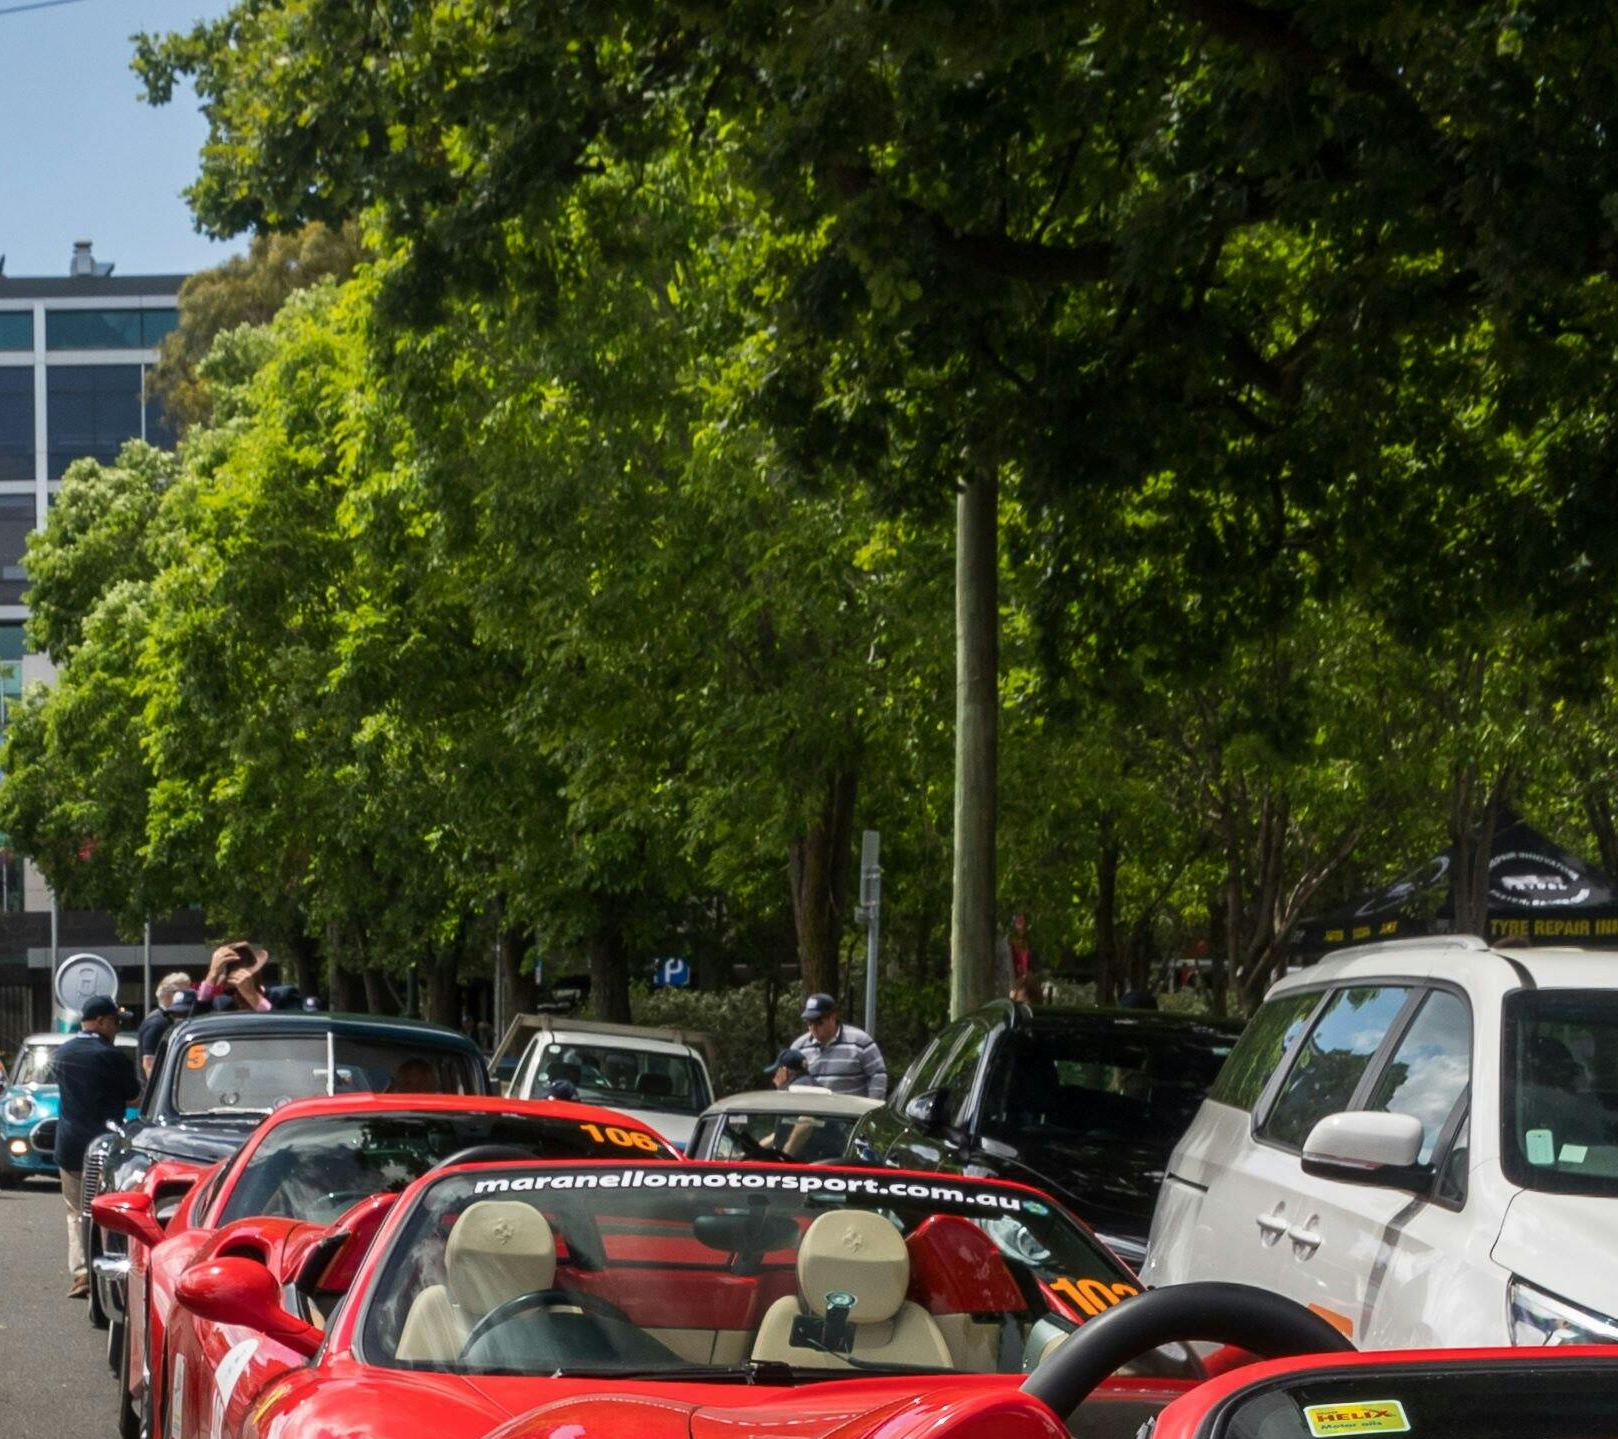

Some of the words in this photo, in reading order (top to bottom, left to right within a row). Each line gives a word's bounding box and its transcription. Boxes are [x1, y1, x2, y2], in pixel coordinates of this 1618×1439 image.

[1490, 919, 1529, 937] TYRE
[1534, 917, 1590, 937] REPAIR
[186, 1044, 208, 1070] 5
[579, 1123, 659, 1152] 106
[474, 1170, 1022, 1212] maranellomotorsport.com.au
[1317, 1408, 1396, 1422] HELIX
